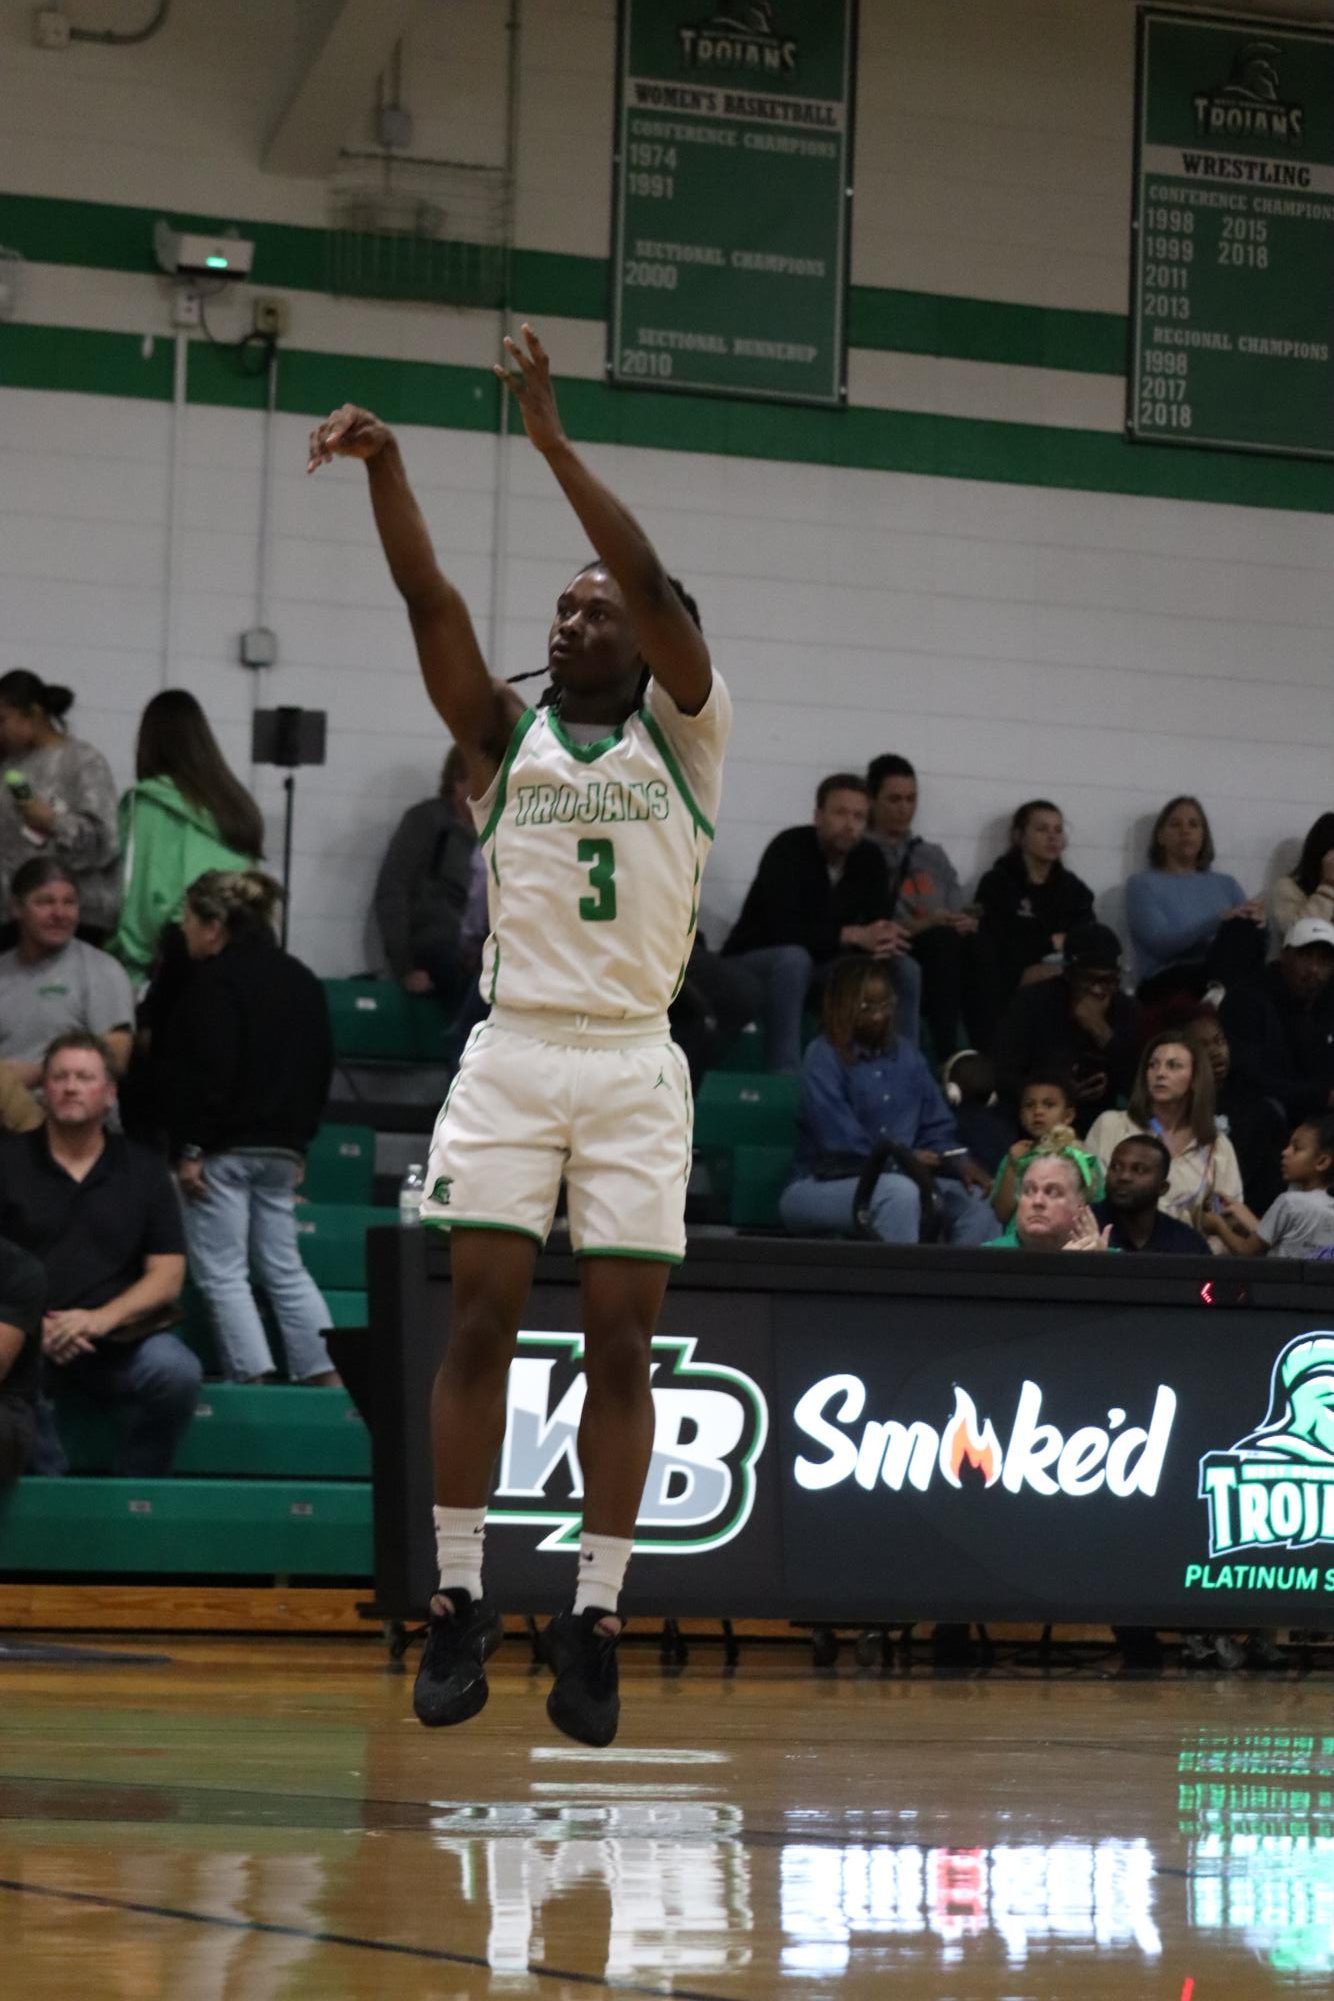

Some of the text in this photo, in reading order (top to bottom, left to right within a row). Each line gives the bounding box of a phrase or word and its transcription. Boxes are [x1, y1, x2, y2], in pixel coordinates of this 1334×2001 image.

[634, 83, 837, 127] WOMEN'S BASKETBALL
[629, 143, 677, 170] 1974
[1182, 152, 1310, 187] WRESTLING
[628, 173, 674, 199] 1991
[1149, 185, 1248, 211] CONFERENCE
[1147, 208, 1194, 234] 1998
[1221, 216, 1267, 242] 2015
[1146, 236, 1194, 262] 1999
[1217, 241, 1269, 269] 2018
[1144, 264, 1188, 290] 2011
[1143, 292, 1190, 320] 2013
[1152, 327, 1329, 361] REGIONAL CHAMPIONS
[621, 349, 673, 377] 2010
[1143, 350, 1188, 376] 1998
[1141, 376, 1187, 402] 2017
[1140, 402, 1192, 429] 2018
[516, 779, 669, 826] TROJANS
[576, 837, 617, 921] 3
[1184, 1564, 1319, 1592] PLATINUM
